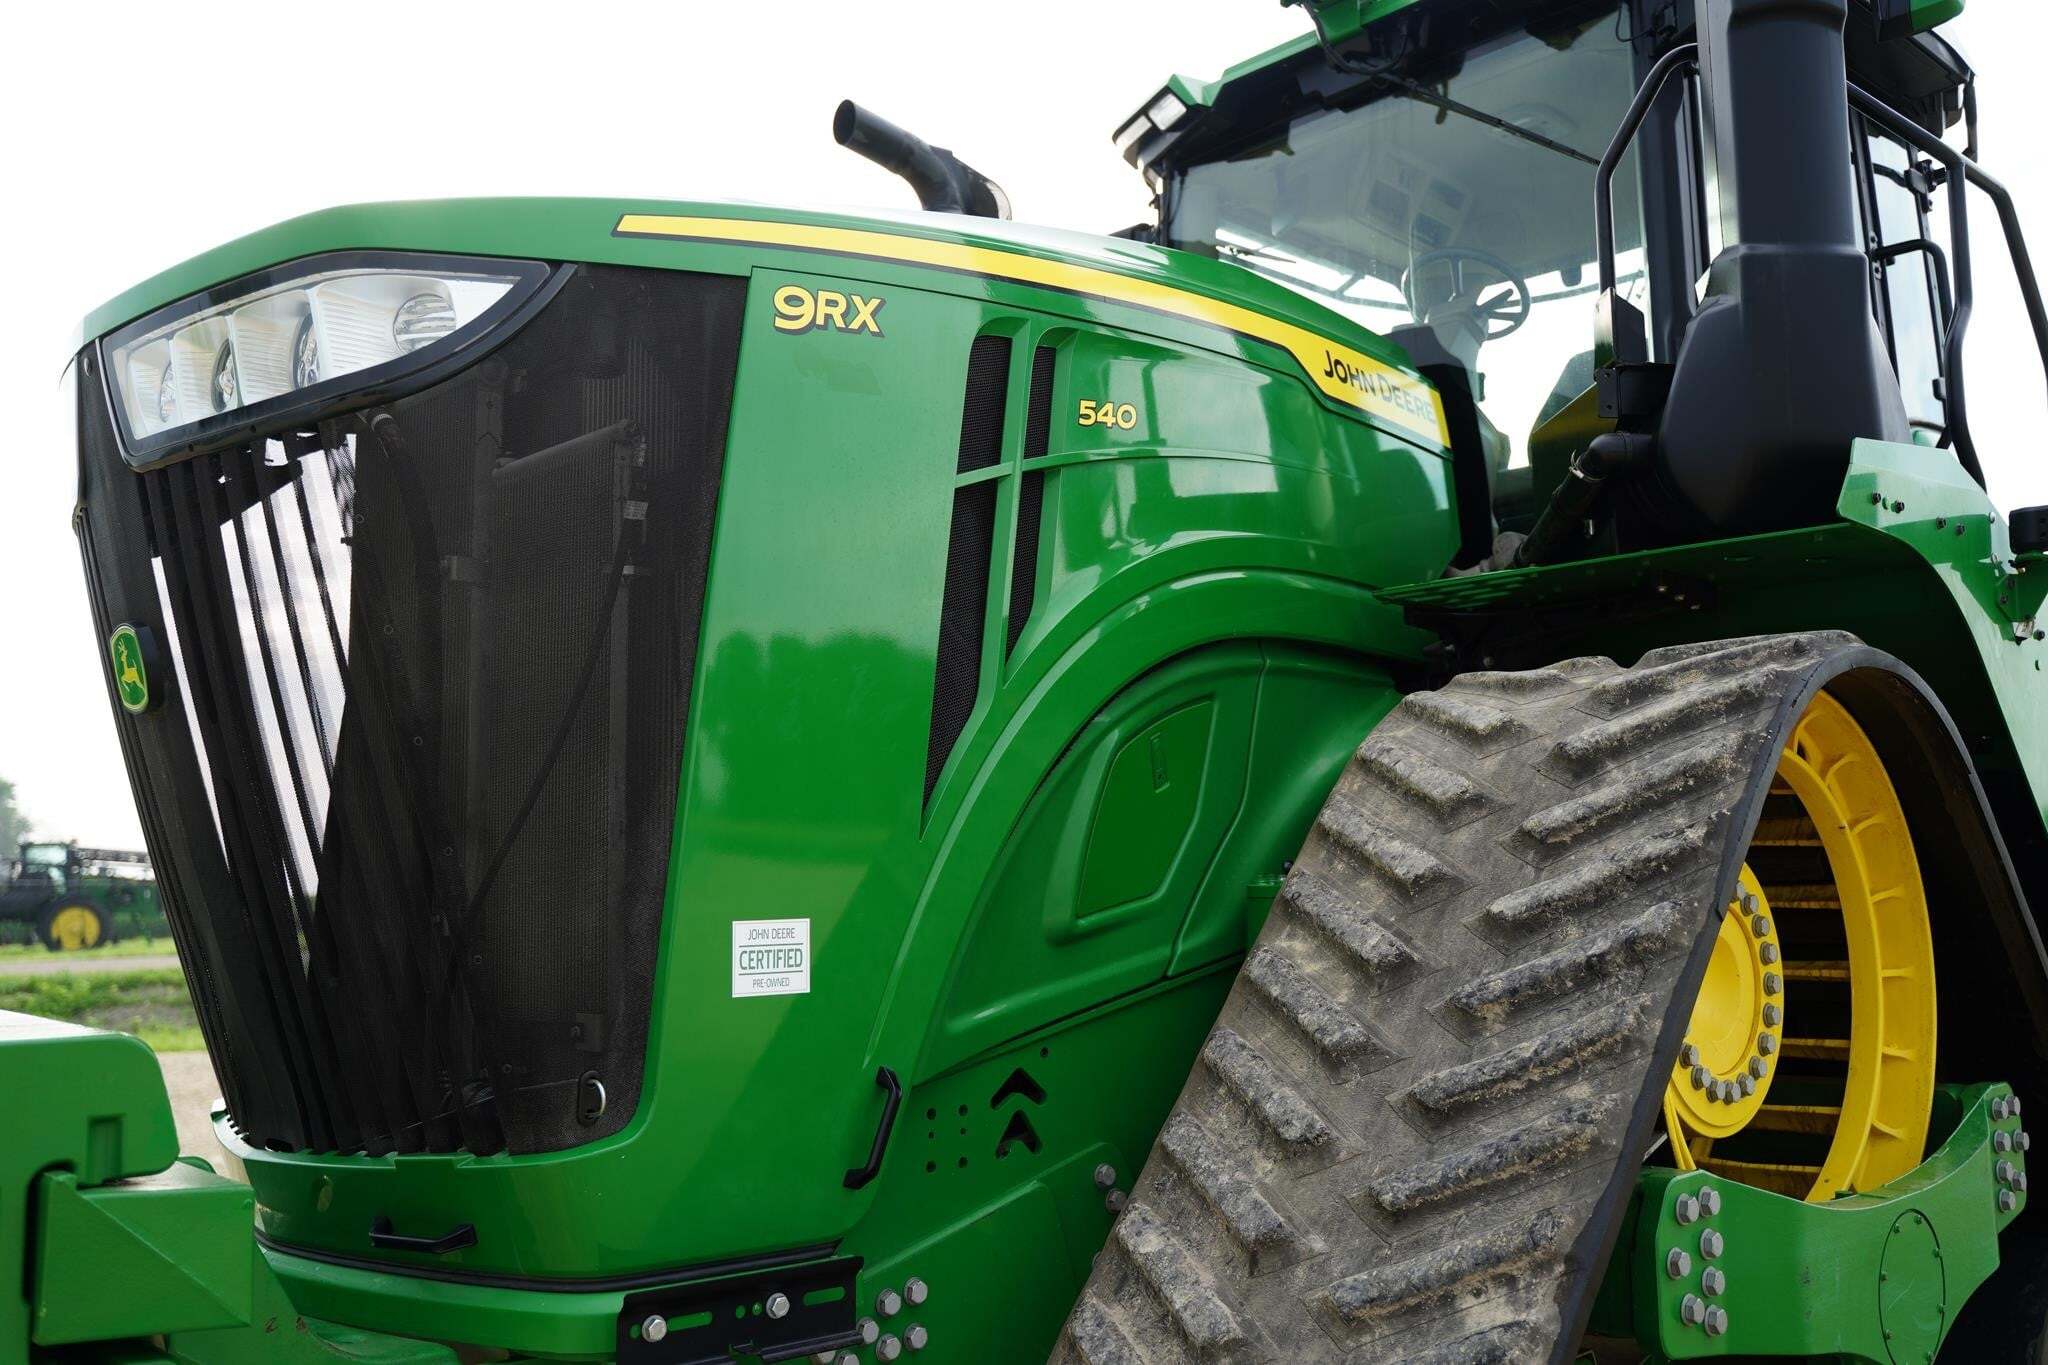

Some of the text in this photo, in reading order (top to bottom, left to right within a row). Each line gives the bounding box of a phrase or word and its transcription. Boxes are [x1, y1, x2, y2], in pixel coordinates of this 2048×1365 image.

[773, 284, 887, 338] 9RX
[1324, 350, 1436, 424] JOHN DEERE
[1078, 399, 1137, 430] 540
[748, 928, 795, 941] JOHN DEERE
[739, 948, 803, 970] CERTIFIED
[752, 977, 789, 988] PRE-OWNED
